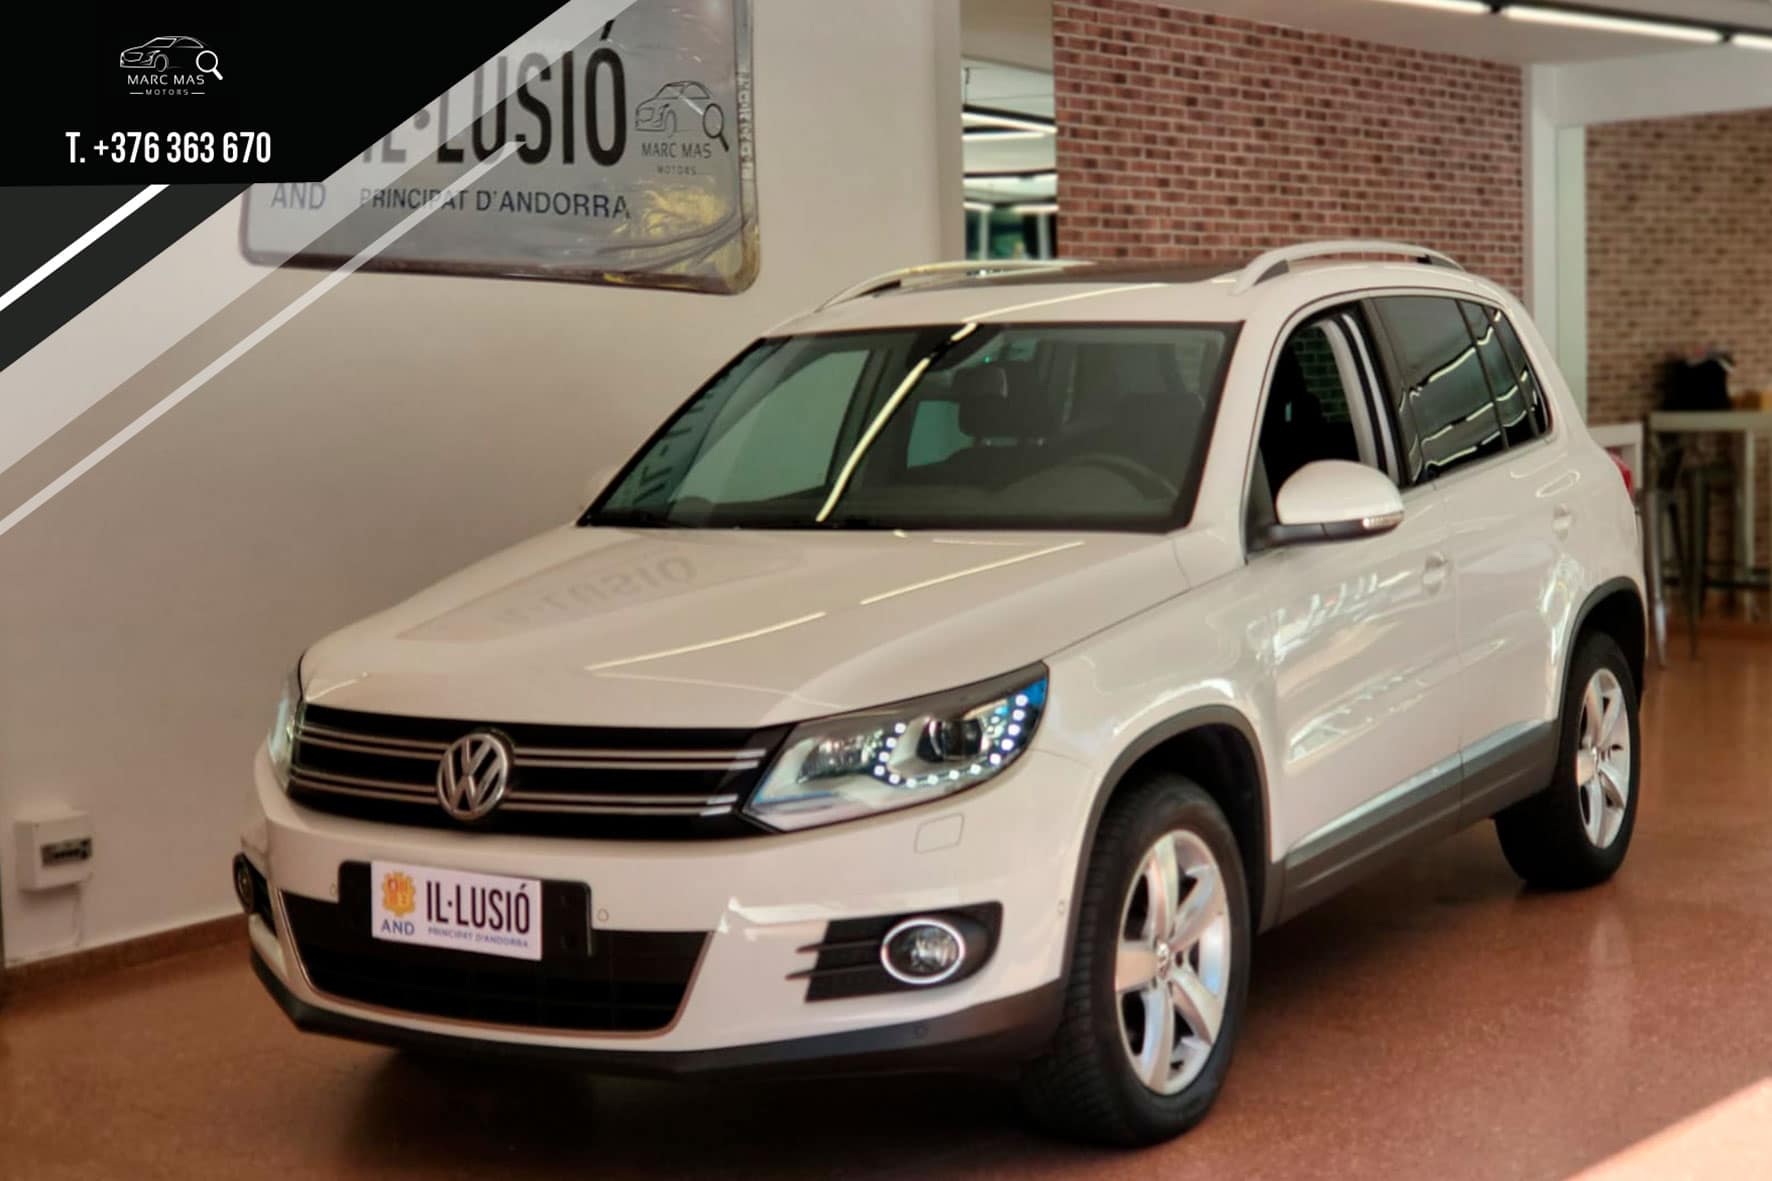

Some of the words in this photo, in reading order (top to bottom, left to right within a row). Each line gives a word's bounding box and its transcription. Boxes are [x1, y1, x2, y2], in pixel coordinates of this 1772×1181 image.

[641, 142, 677, 158] MARC
[681, 143, 712, 159] MAS
[657, 165, 697, 176] MOTORS
[271, 182, 326, 210] AND
[476, 190, 631, 219] D'ANDORRA
[381, 919, 415, 937] AND
